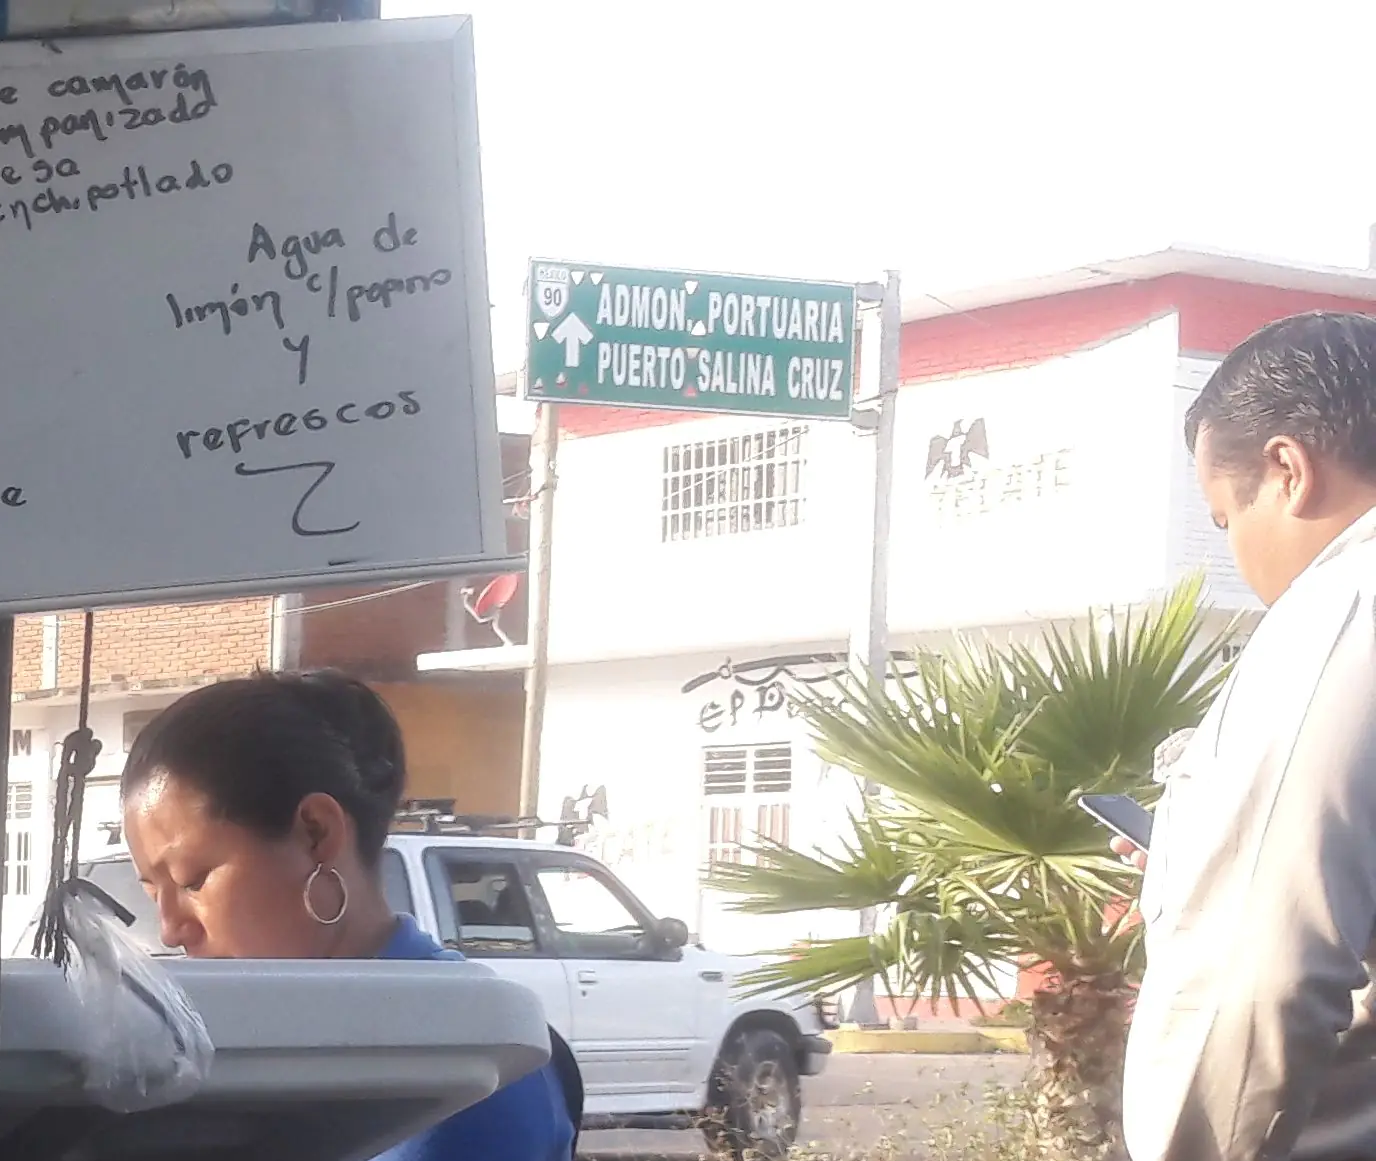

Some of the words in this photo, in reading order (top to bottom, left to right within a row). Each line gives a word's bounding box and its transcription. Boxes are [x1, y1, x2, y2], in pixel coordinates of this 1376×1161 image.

[48, 63, 218, 106] camarón
[248, 222, 346, 280] Agua
[373, 211, 418, 252] de
[166, 282, 284, 335] limón
[544, 287, 561, 306] 90
[707, 291, 845, 344] PORTUARIA
[597, 342, 686, 390] PUERTO
[697, 350, 777, 397] SALINA
[787, 356, 845, 401] CRUZ
[176, 391, 421, 459] refrescos
